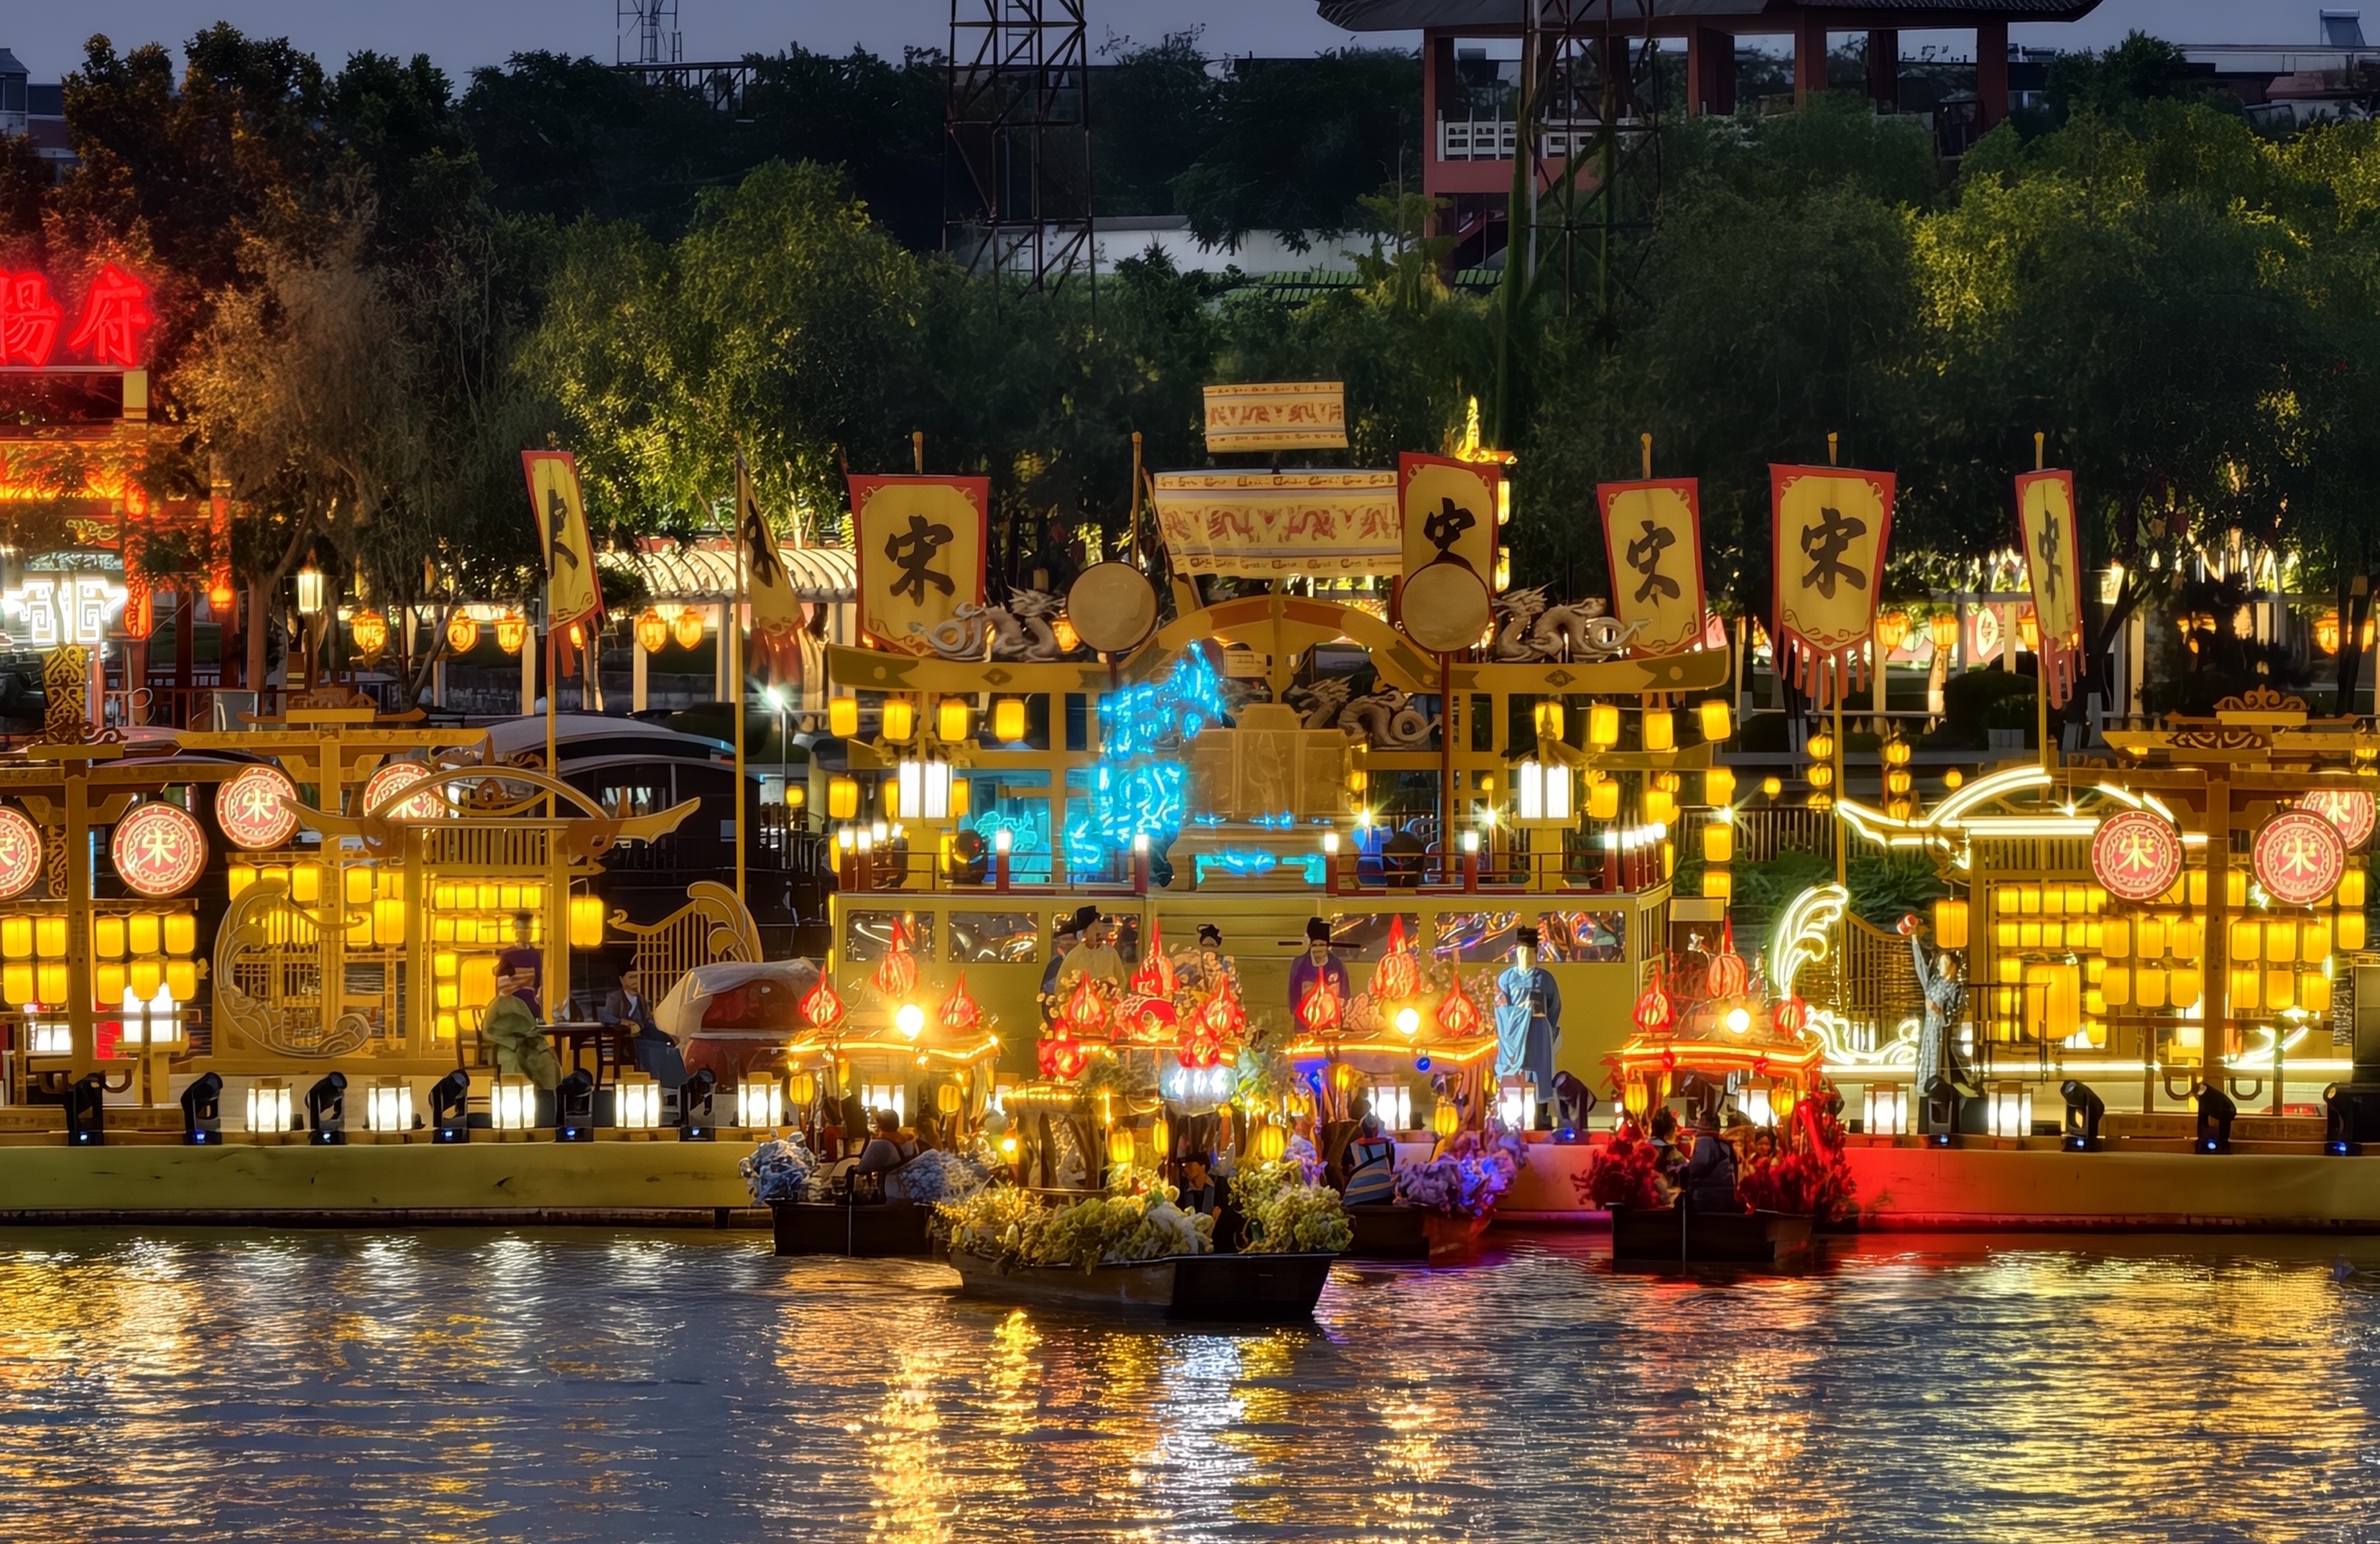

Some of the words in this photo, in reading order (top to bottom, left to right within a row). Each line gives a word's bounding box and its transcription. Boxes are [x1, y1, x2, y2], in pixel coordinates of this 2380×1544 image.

[885, 515, 956, 607] 宋
[1626, 520, 1681, 607] 宋
[1801, 507, 1867, 599] 宋
[239, 787, 275, 824] 宋
[139, 828, 177, 868] 宋
[2118, 834, 2155, 873] 宋
[2279, 836, 2317, 877] 宋
